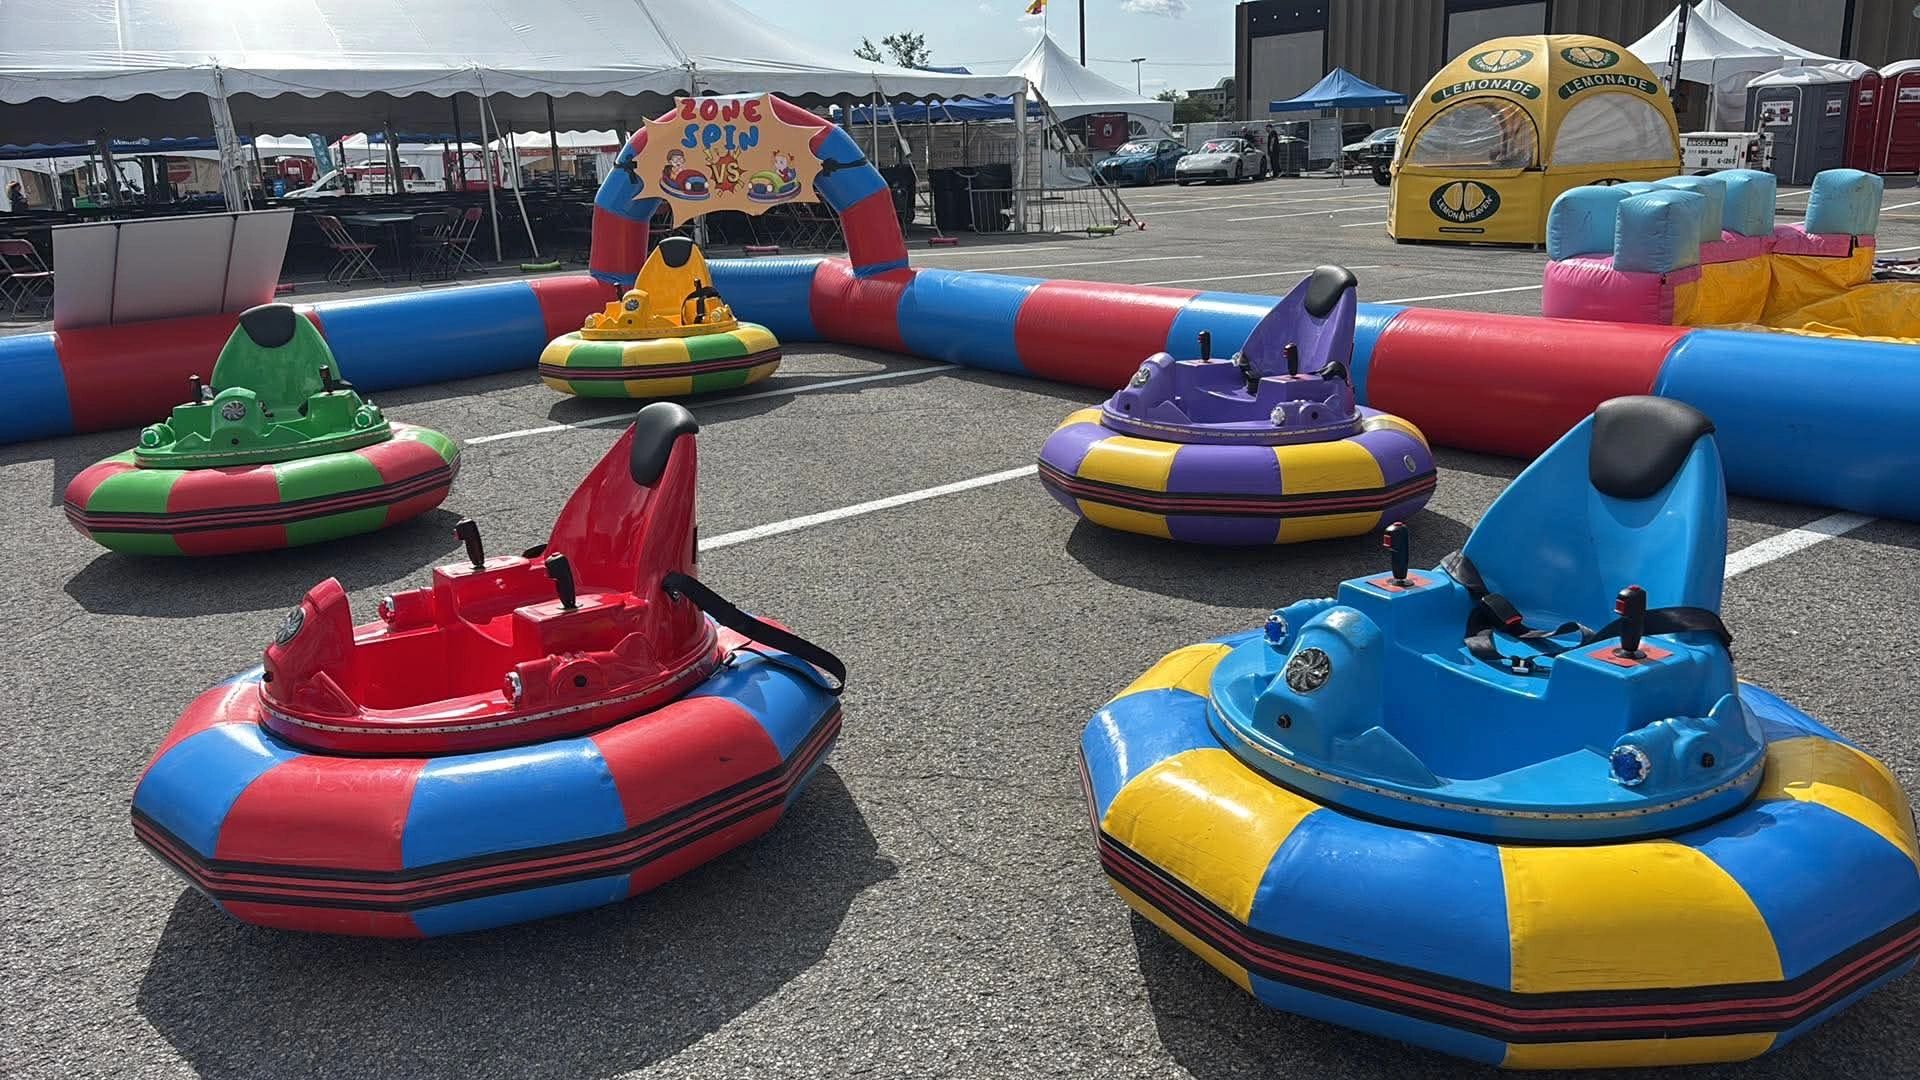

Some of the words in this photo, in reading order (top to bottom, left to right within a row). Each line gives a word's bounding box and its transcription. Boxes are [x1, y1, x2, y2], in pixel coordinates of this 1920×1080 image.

[1442, 79, 1533, 99] LEMONADE
[1565, 73, 1649, 94] LEMONADE
[681, 98, 762, 122] ZONE
[681, 123, 760, 151] SPIN
[712, 162, 740, 184] VS
[1436, 198, 1459, 220] LEMON
[1465, 195, 1494, 220] HEAVEN
